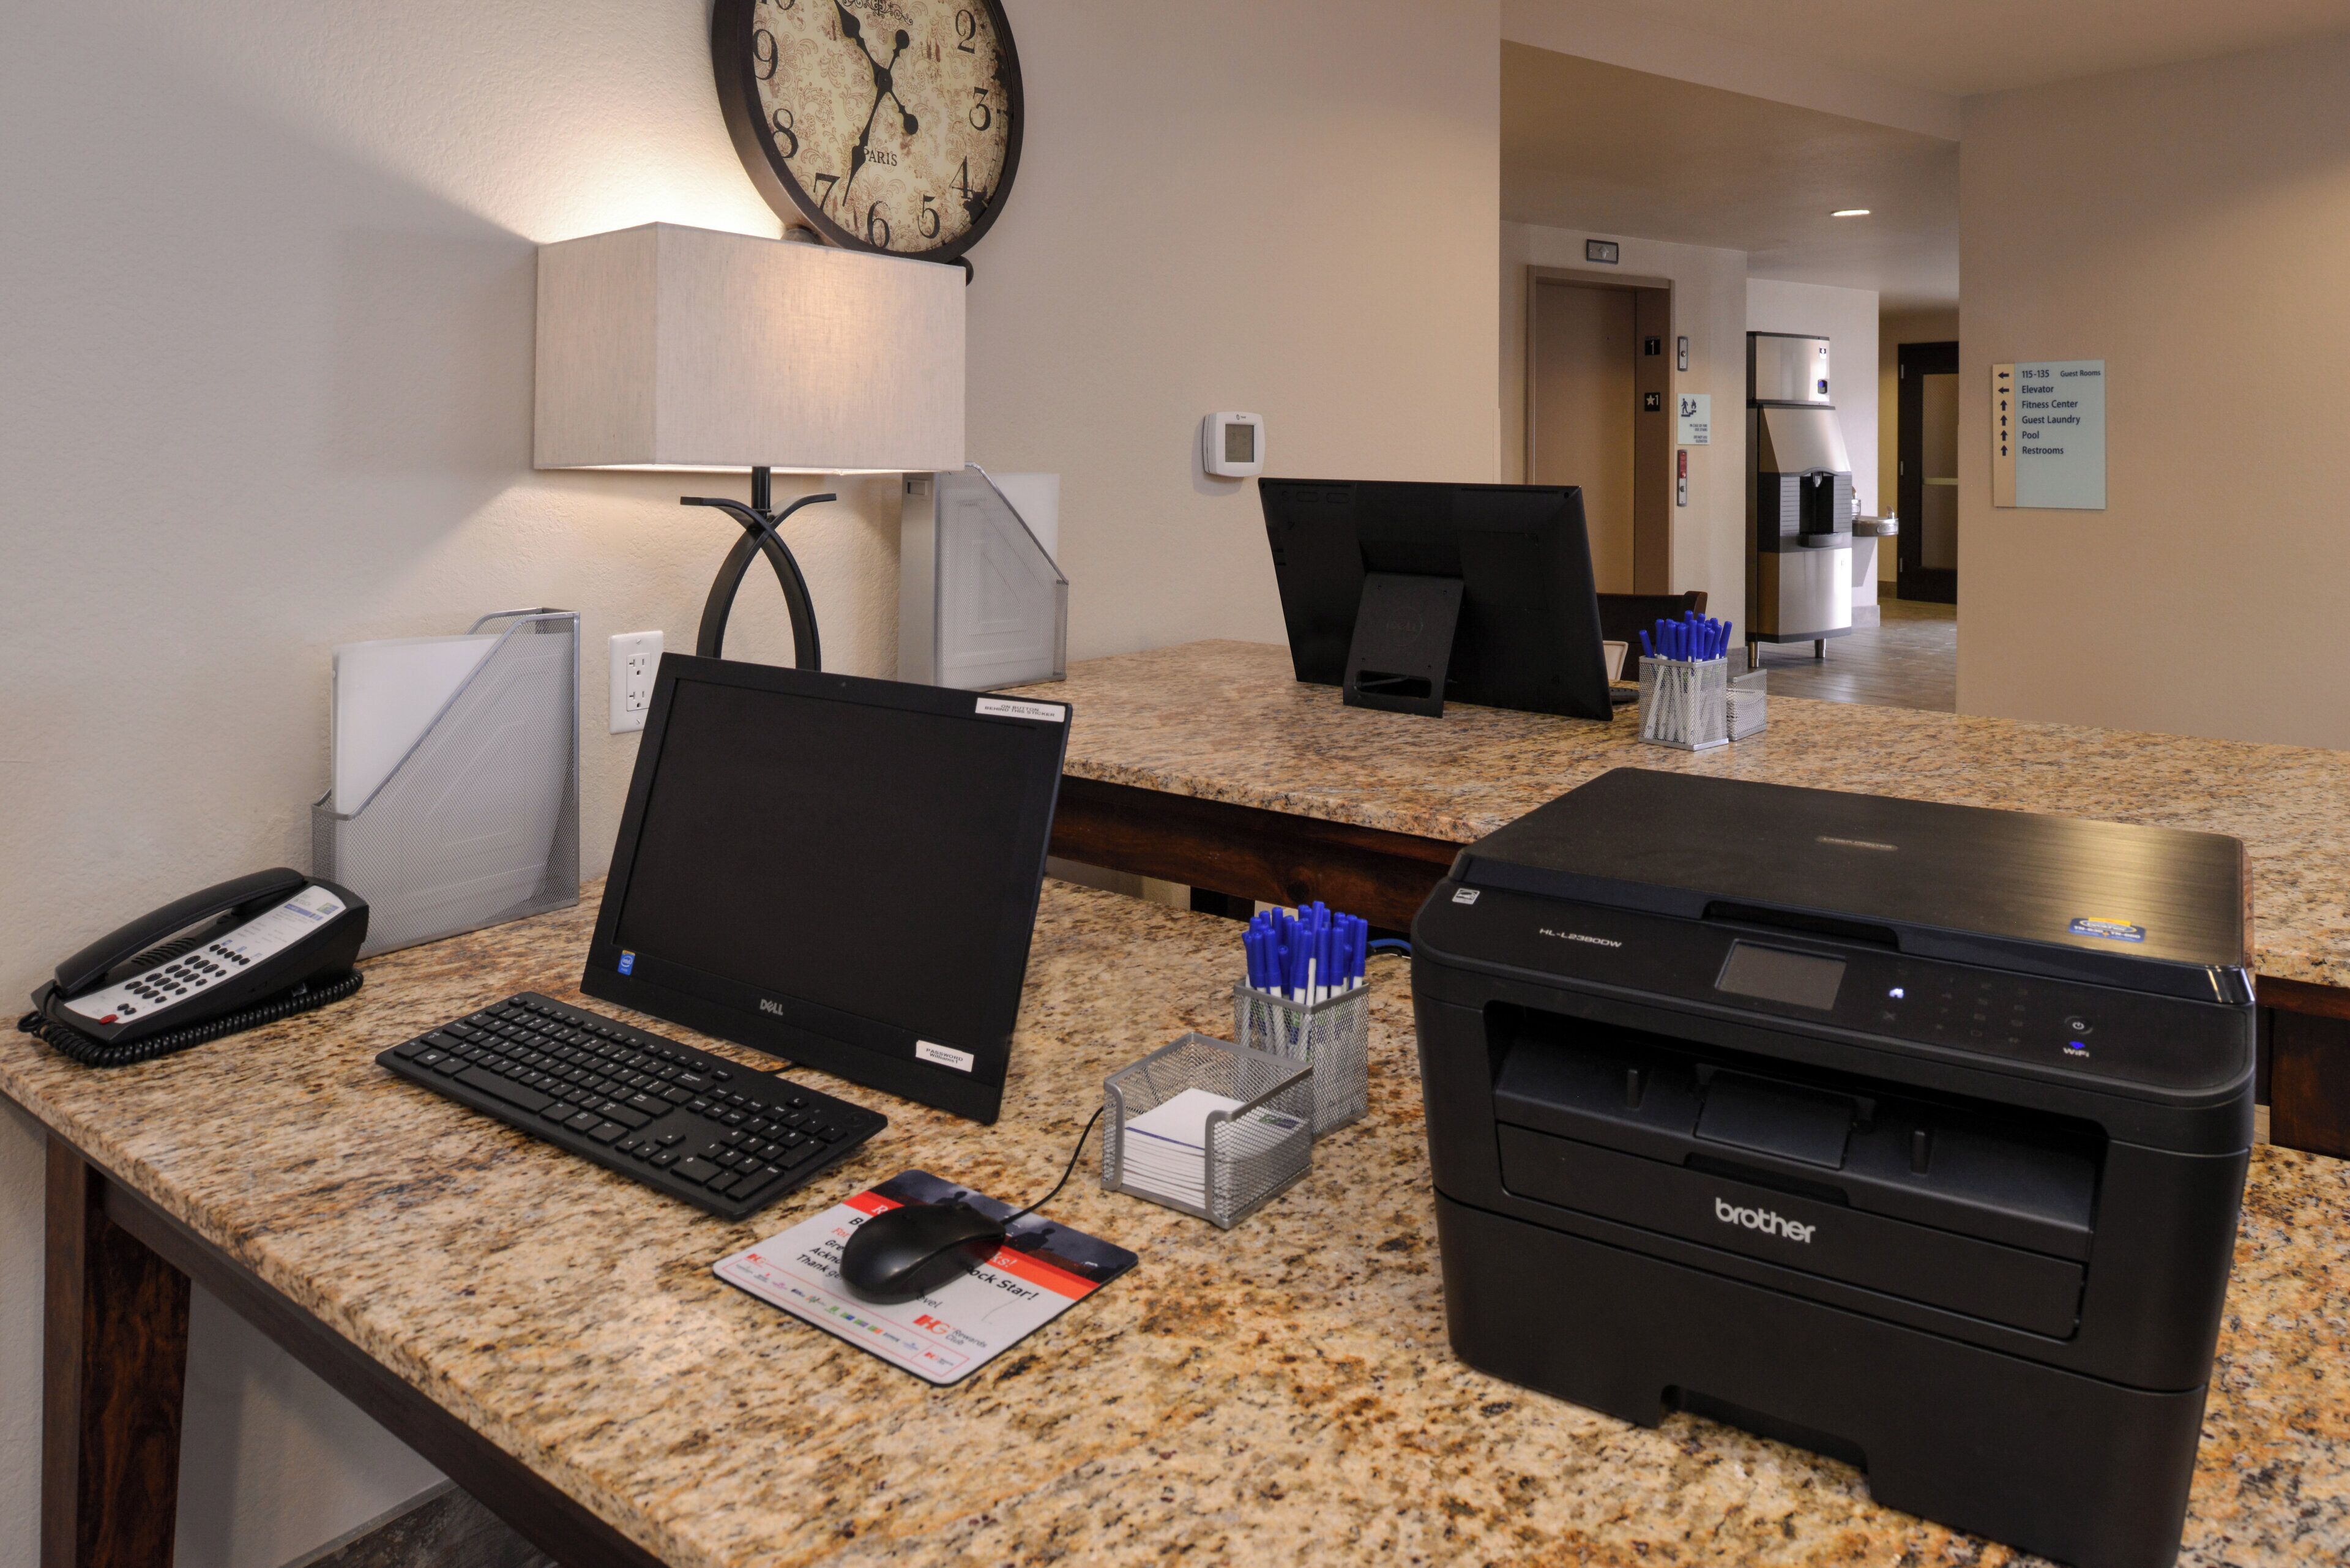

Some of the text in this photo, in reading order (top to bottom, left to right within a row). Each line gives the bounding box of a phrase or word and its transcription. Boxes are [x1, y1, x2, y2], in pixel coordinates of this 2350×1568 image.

[955, 9, 976, 54] 2
[753, 29, 778, 81] 9
[969, 87, 991, 131] 3
[771, 108, 798, 158] 8
[864, 147, 898, 166] PARIS
[949, 155, 974, 200] 4
[813, 172, 840, 211] 7
[867, 201, 890, 248] 6
[917, 193, 940, 239] 5
[2021, 370, 2050, 378] 115-135
[2021, 385, 2054, 394] Elevator
[2021, 400, 2078, 409] Fitness Center
[2022, 415, 2081, 425] Guest Laundry
[2022, 431, 2040, 439] Pool
[2022, 446, 2064, 455] Restrooms
[1539, 928, 1622, 947] HL-L2380DW
[759, 998, 783, 1016] DELL
[925, 1047, 964, 1061] PASSWORD
[2062, 1047, 2090, 1058] WiFi
[848, 1217, 864, 1225] B
[1715, 1197, 1816, 1244] brother
[825, 1239, 845, 1251] Gre
[796, 1254, 829, 1272] Thank
[809, 1247, 841, 1264] Ackno
[991, 1251, 1018, 1268] ks!
[969, 1267, 1040, 1301] ock Star!
[912, 1314, 950, 1335] IHG
[945, 1334, 965, 1346] Club
[952, 1329, 988, 1348] Rewards
